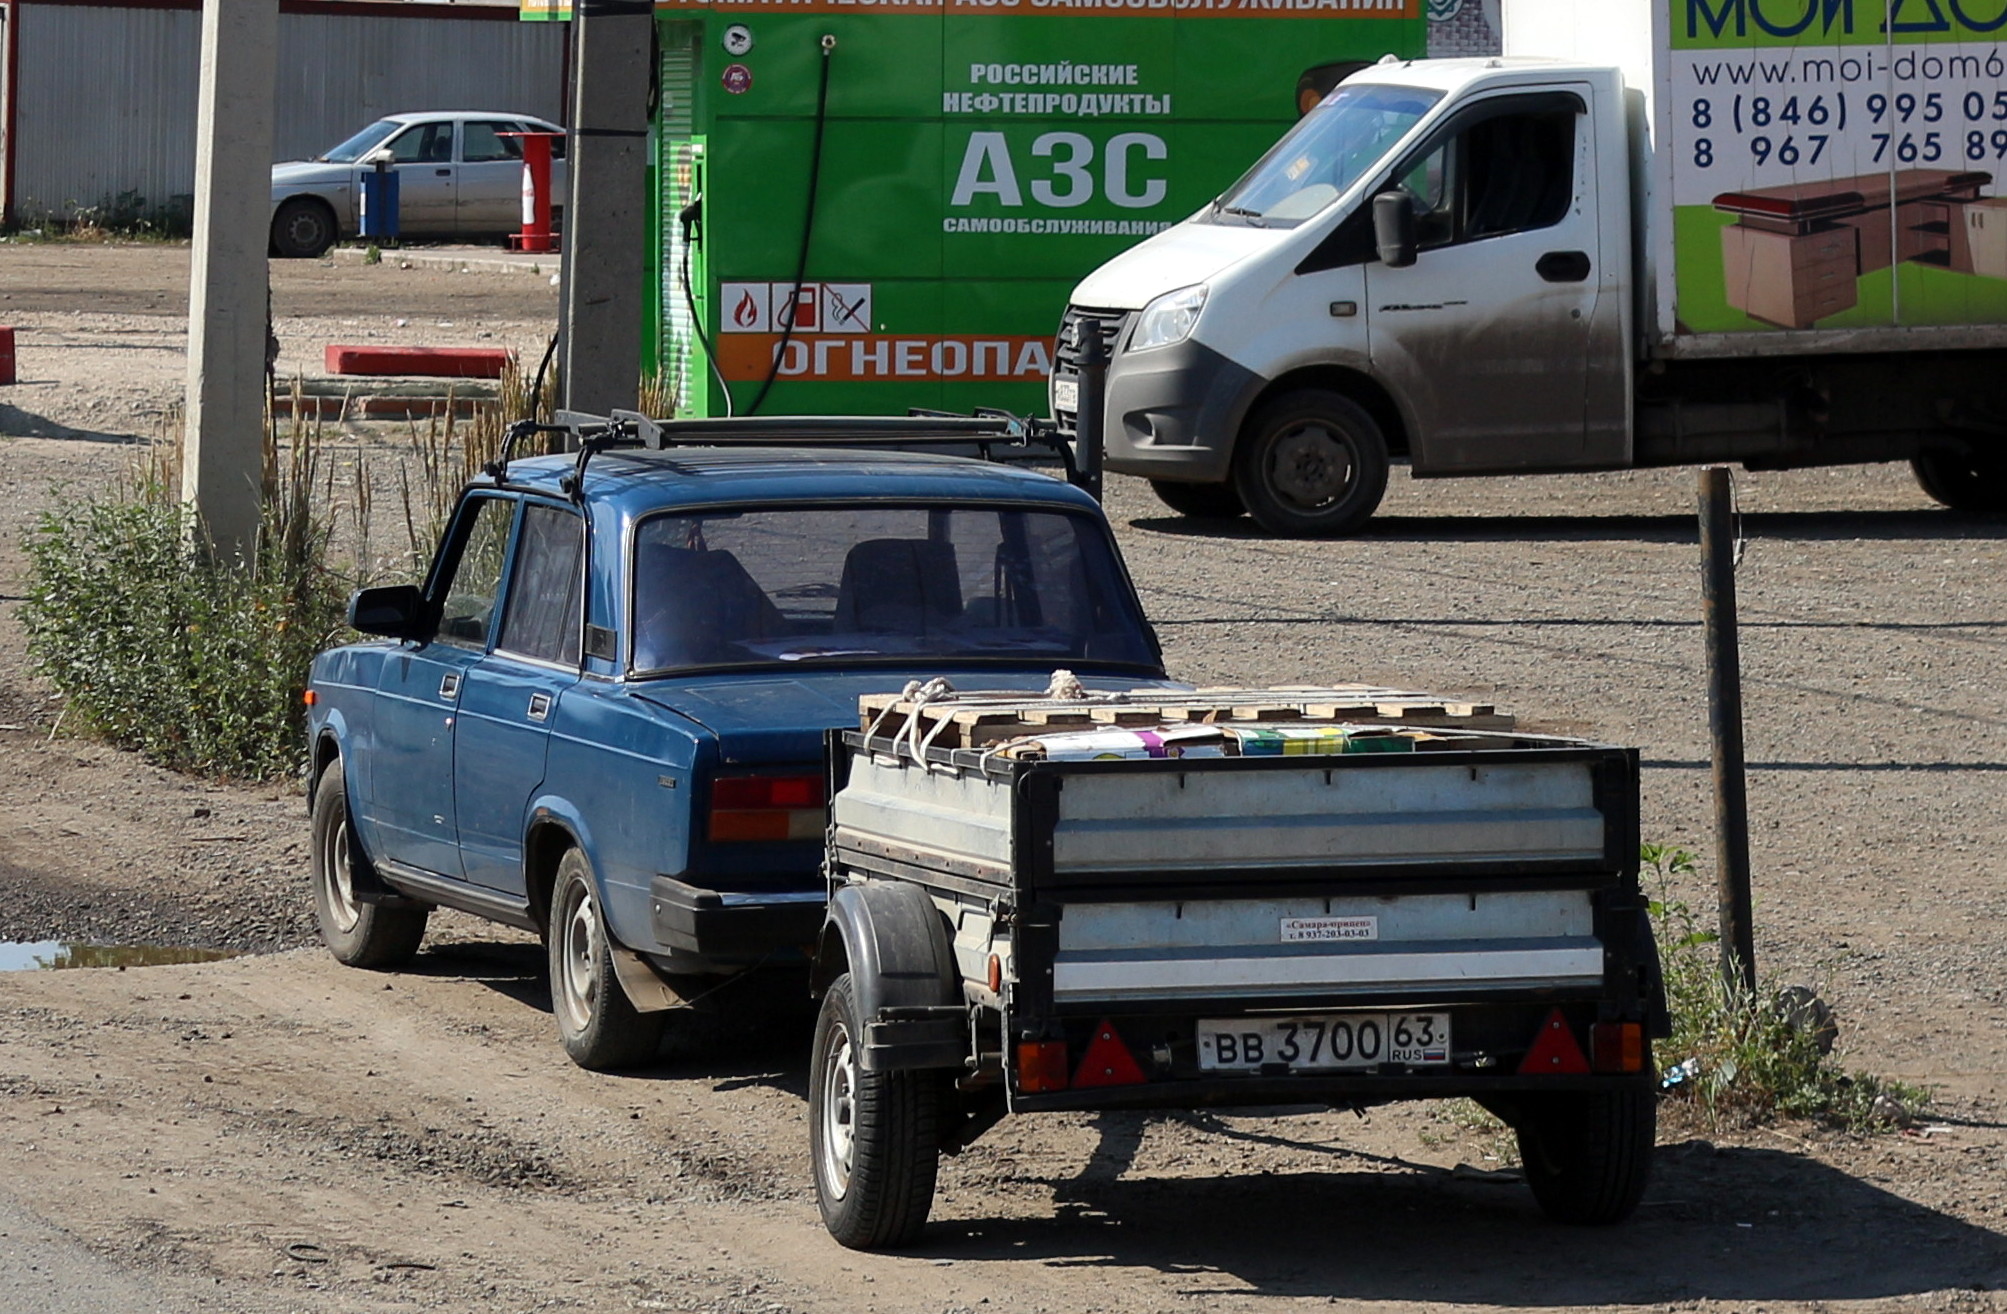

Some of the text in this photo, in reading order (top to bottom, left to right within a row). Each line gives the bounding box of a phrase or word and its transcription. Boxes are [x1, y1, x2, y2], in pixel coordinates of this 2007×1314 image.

[970, 60, 1139, 85] РОССИЙСКИЕ
[1692, 48, 2004, 85] www.moi-dom6
[943, 92, 1171, 117] НЕФТЕПРОДУКТЫ
[1692, 91, 2007, 133] 8 (846) 995 05
[1693, 130, 2007, 168] 8 967 765 89
[950, 131, 1168, 208] АЗС
[943, 218, 1173, 235] САМООБСЛУЖИВАНИЯ
[772, 339, 1051, 376] ОГНЕОПА
[1215, 1016, 1434, 1064] ВВ 3700 63
[1392, 1049, 1422, 1061] RUS
